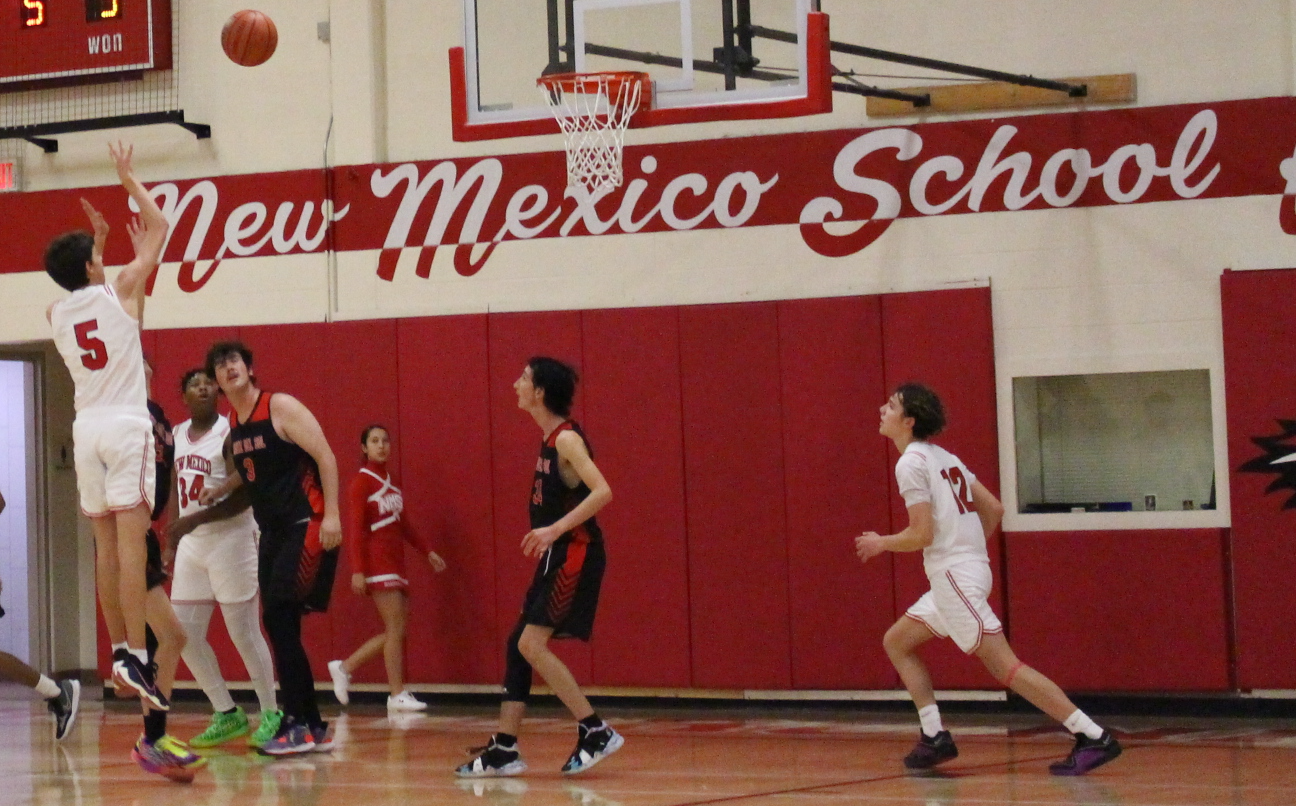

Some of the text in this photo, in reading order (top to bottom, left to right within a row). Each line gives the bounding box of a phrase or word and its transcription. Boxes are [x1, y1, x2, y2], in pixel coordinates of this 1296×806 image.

[88, 33, 123, 54] won
[128, 180, 349, 296] New
[370, 155, 778, 281] Mexico
[800, 109, 1220, 258] School
[74, 319, 108, 371] 5
[243, 457, 256, 482] 3
[940, 466, 979, 515] 12
